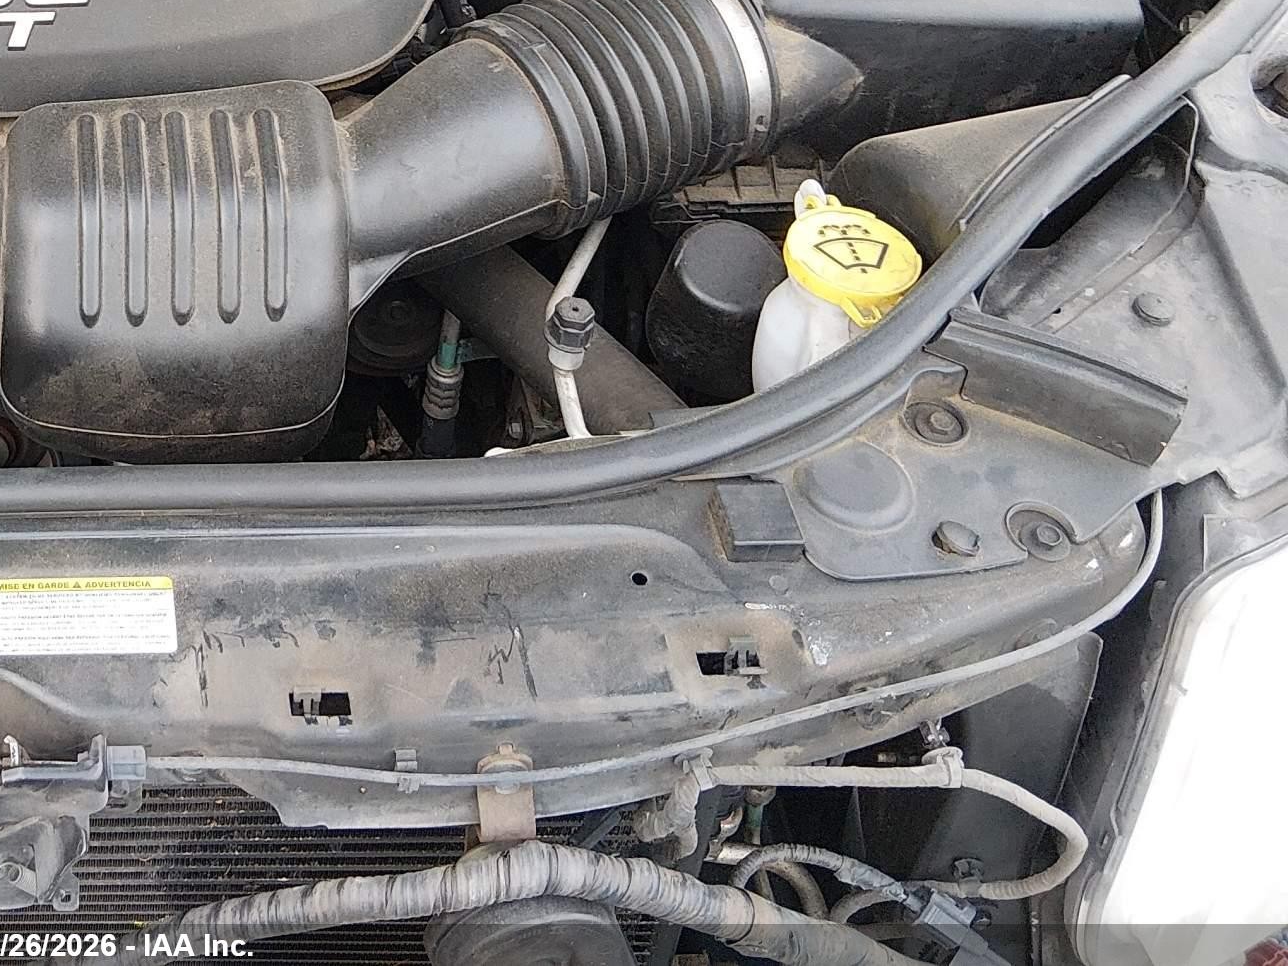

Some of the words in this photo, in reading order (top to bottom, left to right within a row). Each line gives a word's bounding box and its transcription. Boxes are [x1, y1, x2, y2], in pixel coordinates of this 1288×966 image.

[23, 582, 37, 591] EN
[38, 581, 69, 590] GARDE
[85, 580, 152, 589] ADVERTENCIA
